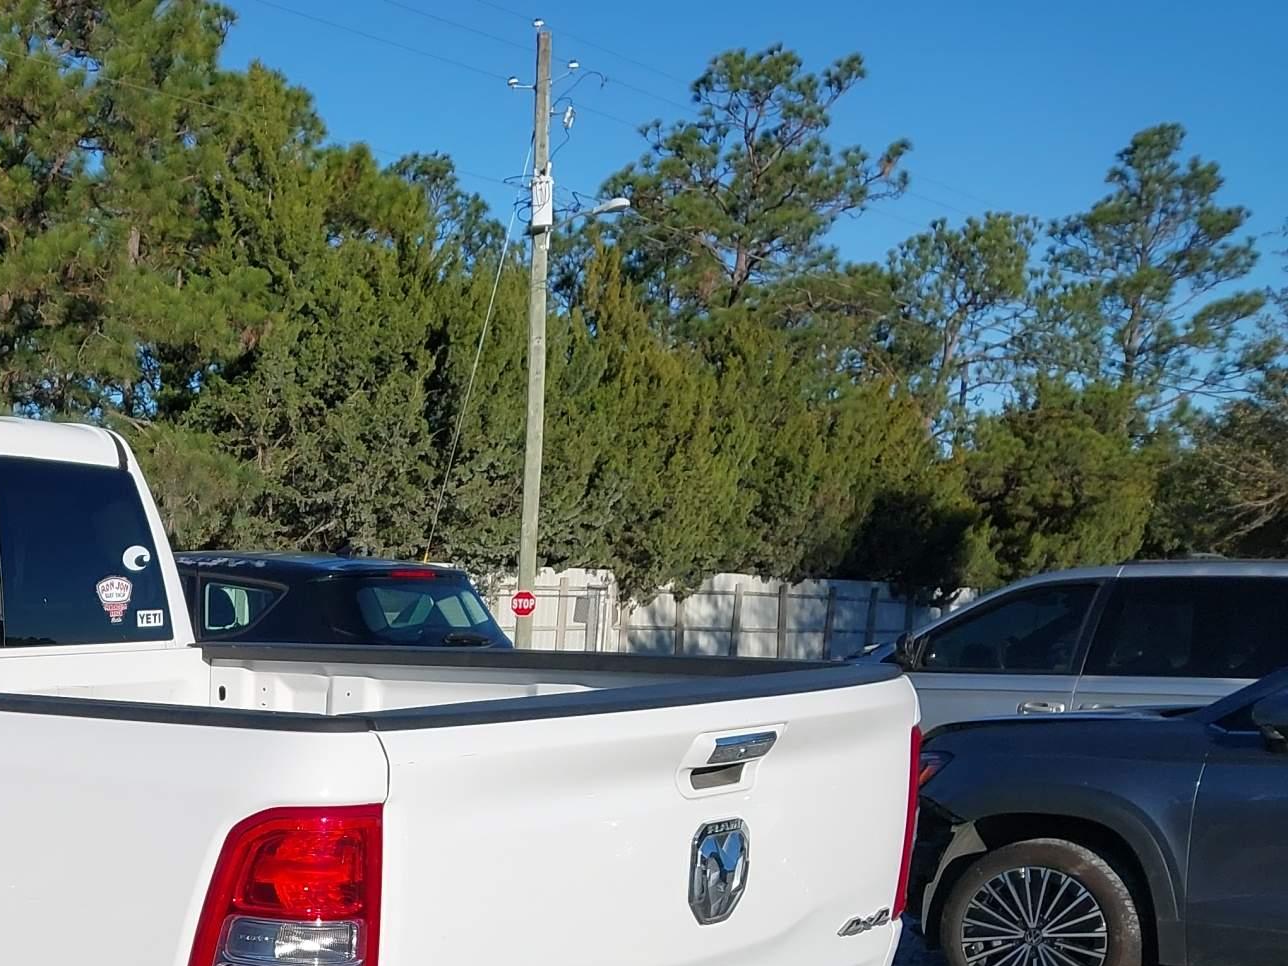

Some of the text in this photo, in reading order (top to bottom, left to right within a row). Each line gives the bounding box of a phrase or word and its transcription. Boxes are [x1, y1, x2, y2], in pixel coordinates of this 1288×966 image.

[101, 581, 115, 595] RON
[512, 598, 535, 610] STOP
[138, 612, 162, 625] YETI
[707, 820, 742, 835] RAM
